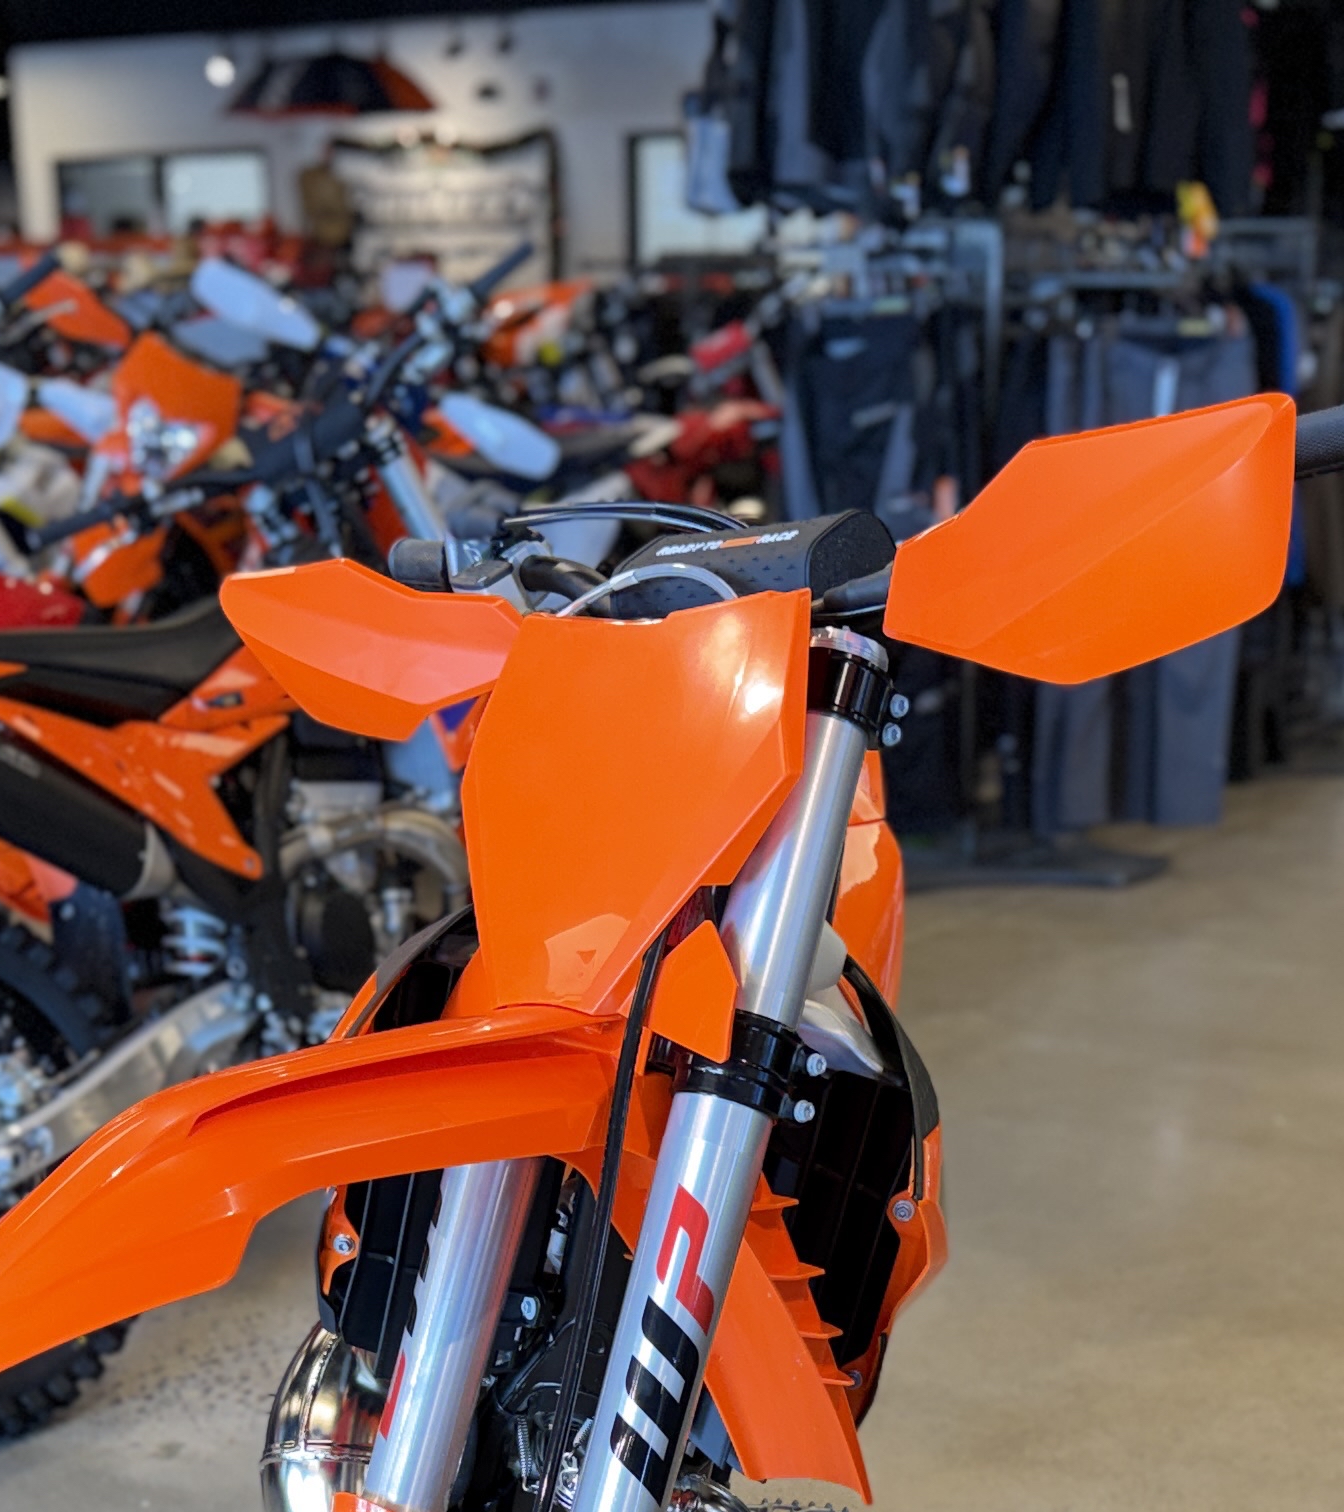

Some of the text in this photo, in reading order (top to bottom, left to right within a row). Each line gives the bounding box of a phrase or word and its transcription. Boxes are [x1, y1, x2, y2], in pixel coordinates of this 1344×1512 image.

[656, 530, 800, 557] READY TO RACE
